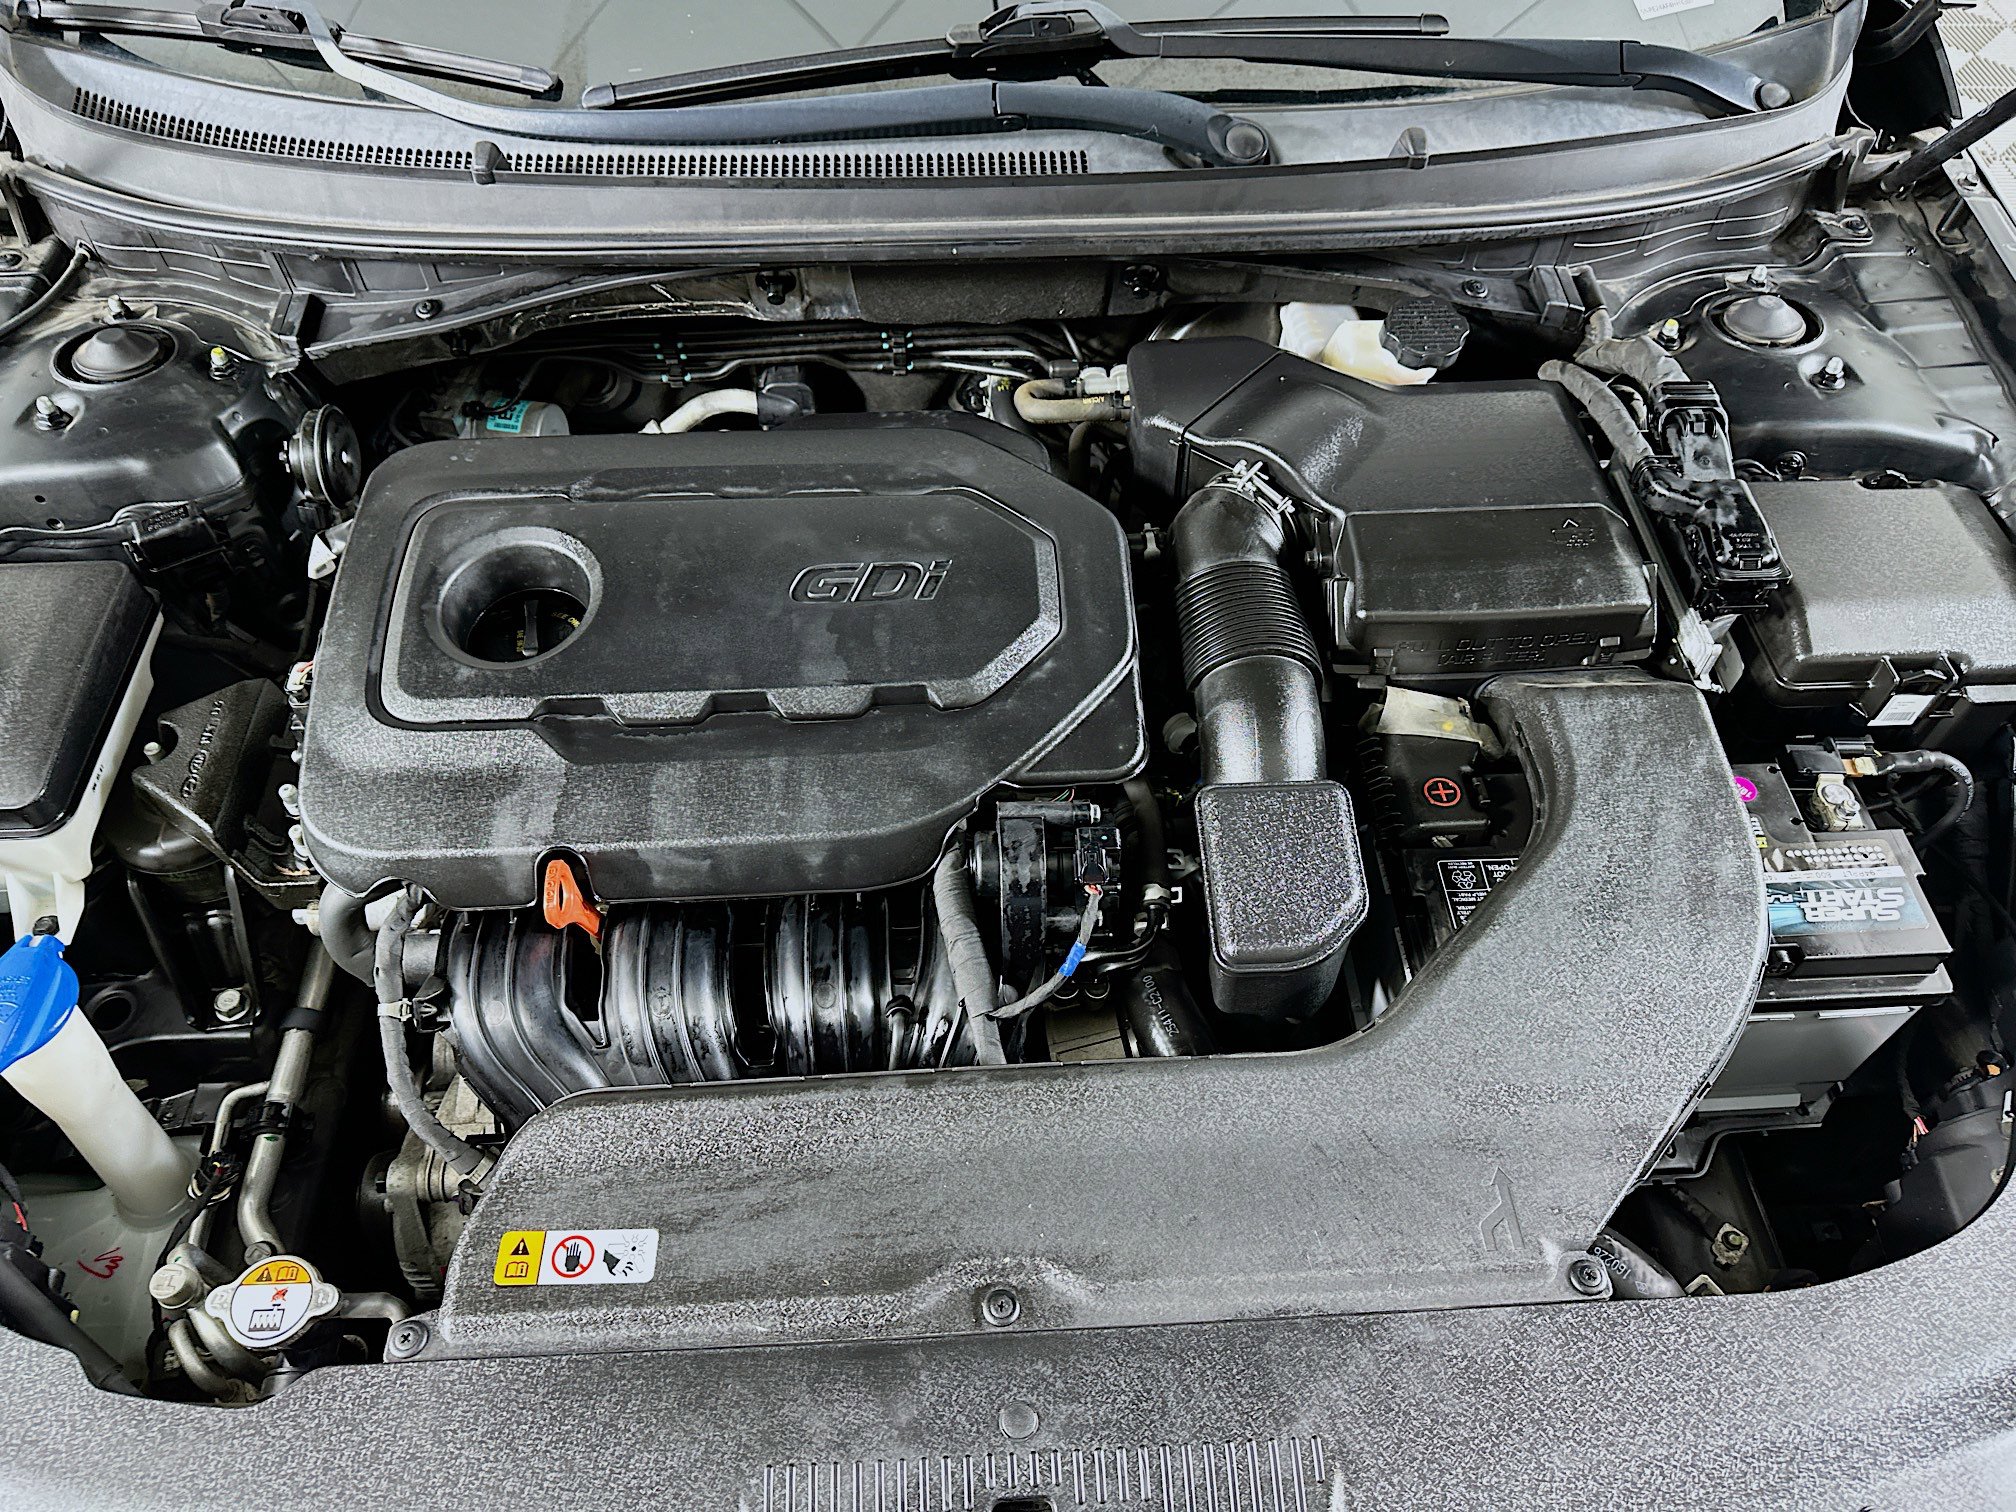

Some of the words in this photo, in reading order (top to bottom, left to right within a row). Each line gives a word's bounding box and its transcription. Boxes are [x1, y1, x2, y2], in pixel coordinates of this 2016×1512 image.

[789, 559, 953, 603] GDi
[1395, 640, 1451, 652] PULL
[1456, 637, 1503, 651] OUT
[1506, 635, 1534, 649] TO
[1799, 887, 1905, 909] START
[1803, 905, 1900, 922] SUPER
[1142, 975, 1180, 1037] 25411-C2100
[1594, 1246, 1632, 1280] 160226
